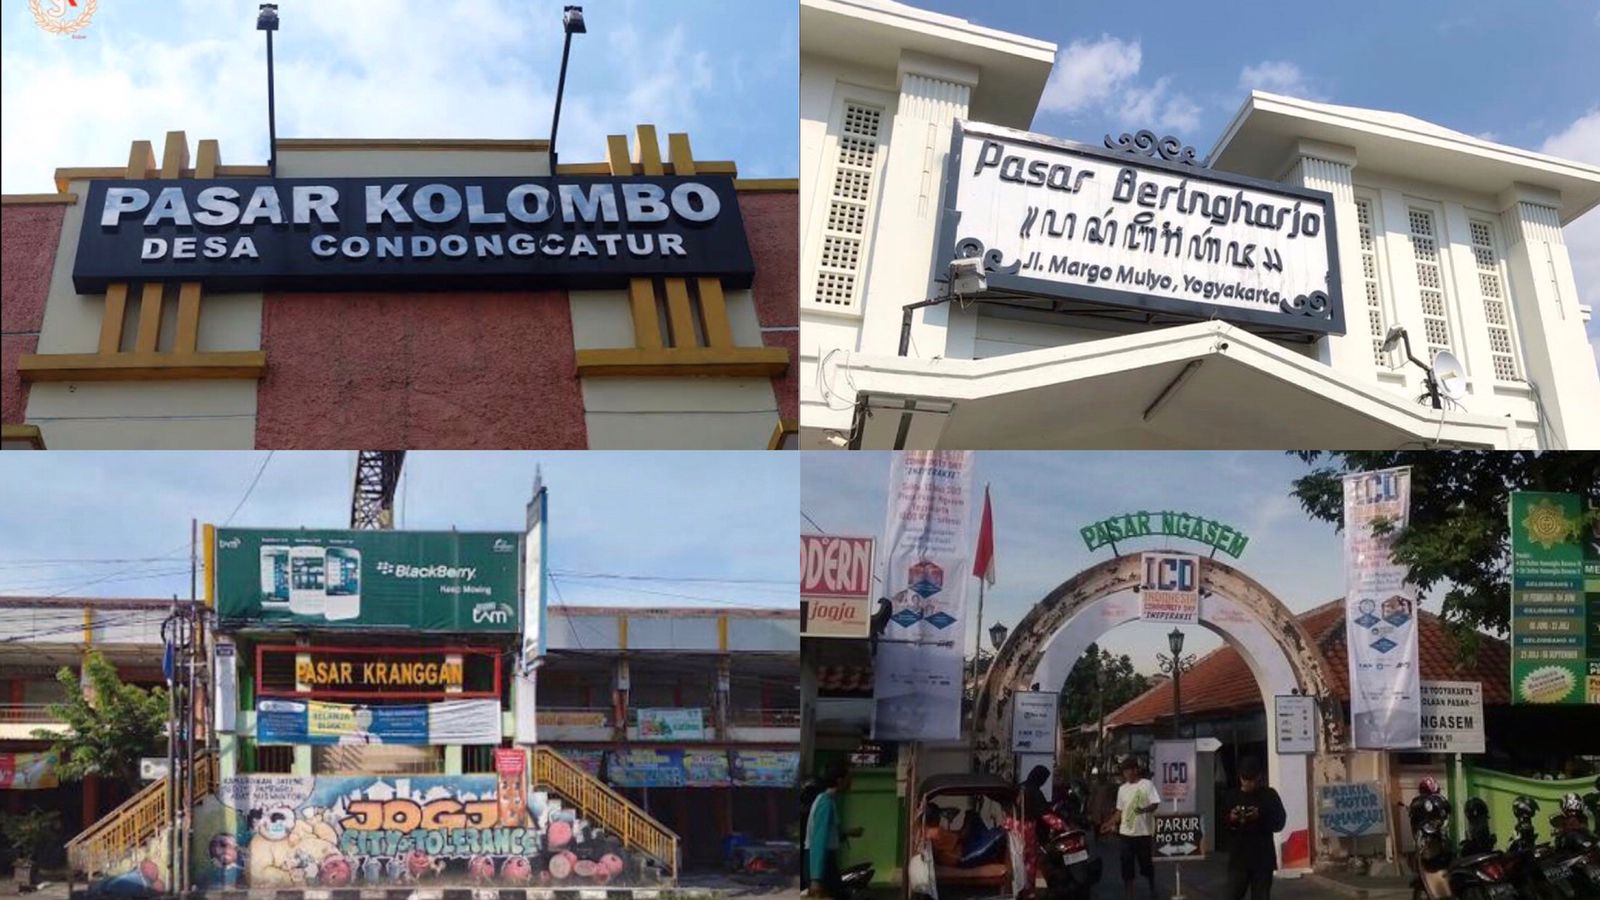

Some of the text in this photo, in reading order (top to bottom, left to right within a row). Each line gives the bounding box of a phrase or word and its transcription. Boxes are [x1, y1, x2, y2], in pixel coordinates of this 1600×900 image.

[974, 138, 1320, 239] Pasar Beringharjo
[101, 182, 721, 227] PASAR KOLOMBO
[141, 233, 688, 260] DESA CONDONGCATUR
[1022, 252, 1281, 305] Jl. Margo Mulyo, Yogyakarta
[1080, 510, 1249, 559] PASAR NGASEM
[396, 564, 475, 581] BlackBerry
[1145, 557, 1197, 591] ICD
[296, 662, 463, 686] PASAR KRANGGAN
[1420, 715, 1474, 729] NGASEM
[1162, 762, 1188, 783] ICD
[1335, 793, 1378, 809] MOTOR
[342, 799, 539, 832] JOGJ
[1156, 817, 1199, 832] PARKIR
[339, 829, 398, 856] CITY
[1156, 832, 1195, 843] MOTOR
